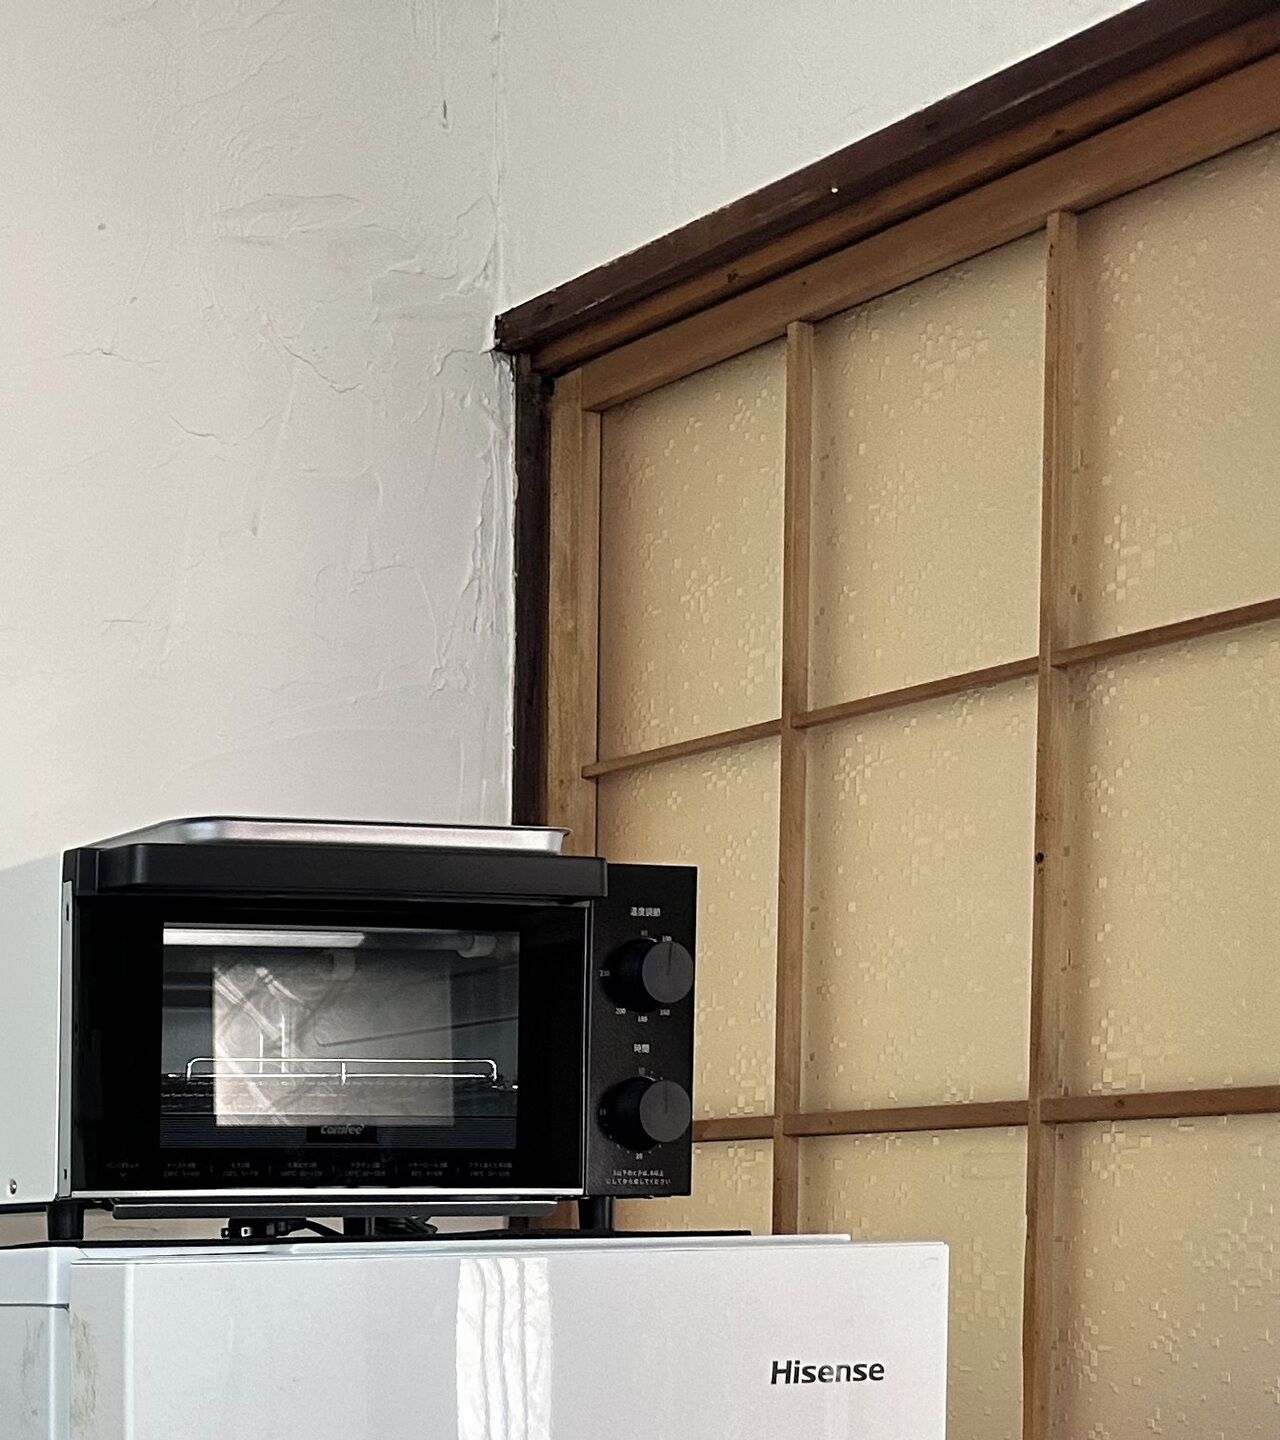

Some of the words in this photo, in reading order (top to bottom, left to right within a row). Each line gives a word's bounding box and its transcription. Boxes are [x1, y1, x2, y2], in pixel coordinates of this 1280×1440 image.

[630, 906, 661, 917] 温度調節
[615, 1007, 626, 1015] 200
[633, 1043, 650, 1054] 時間
[771, 1360, 885, 1385] Hisense
